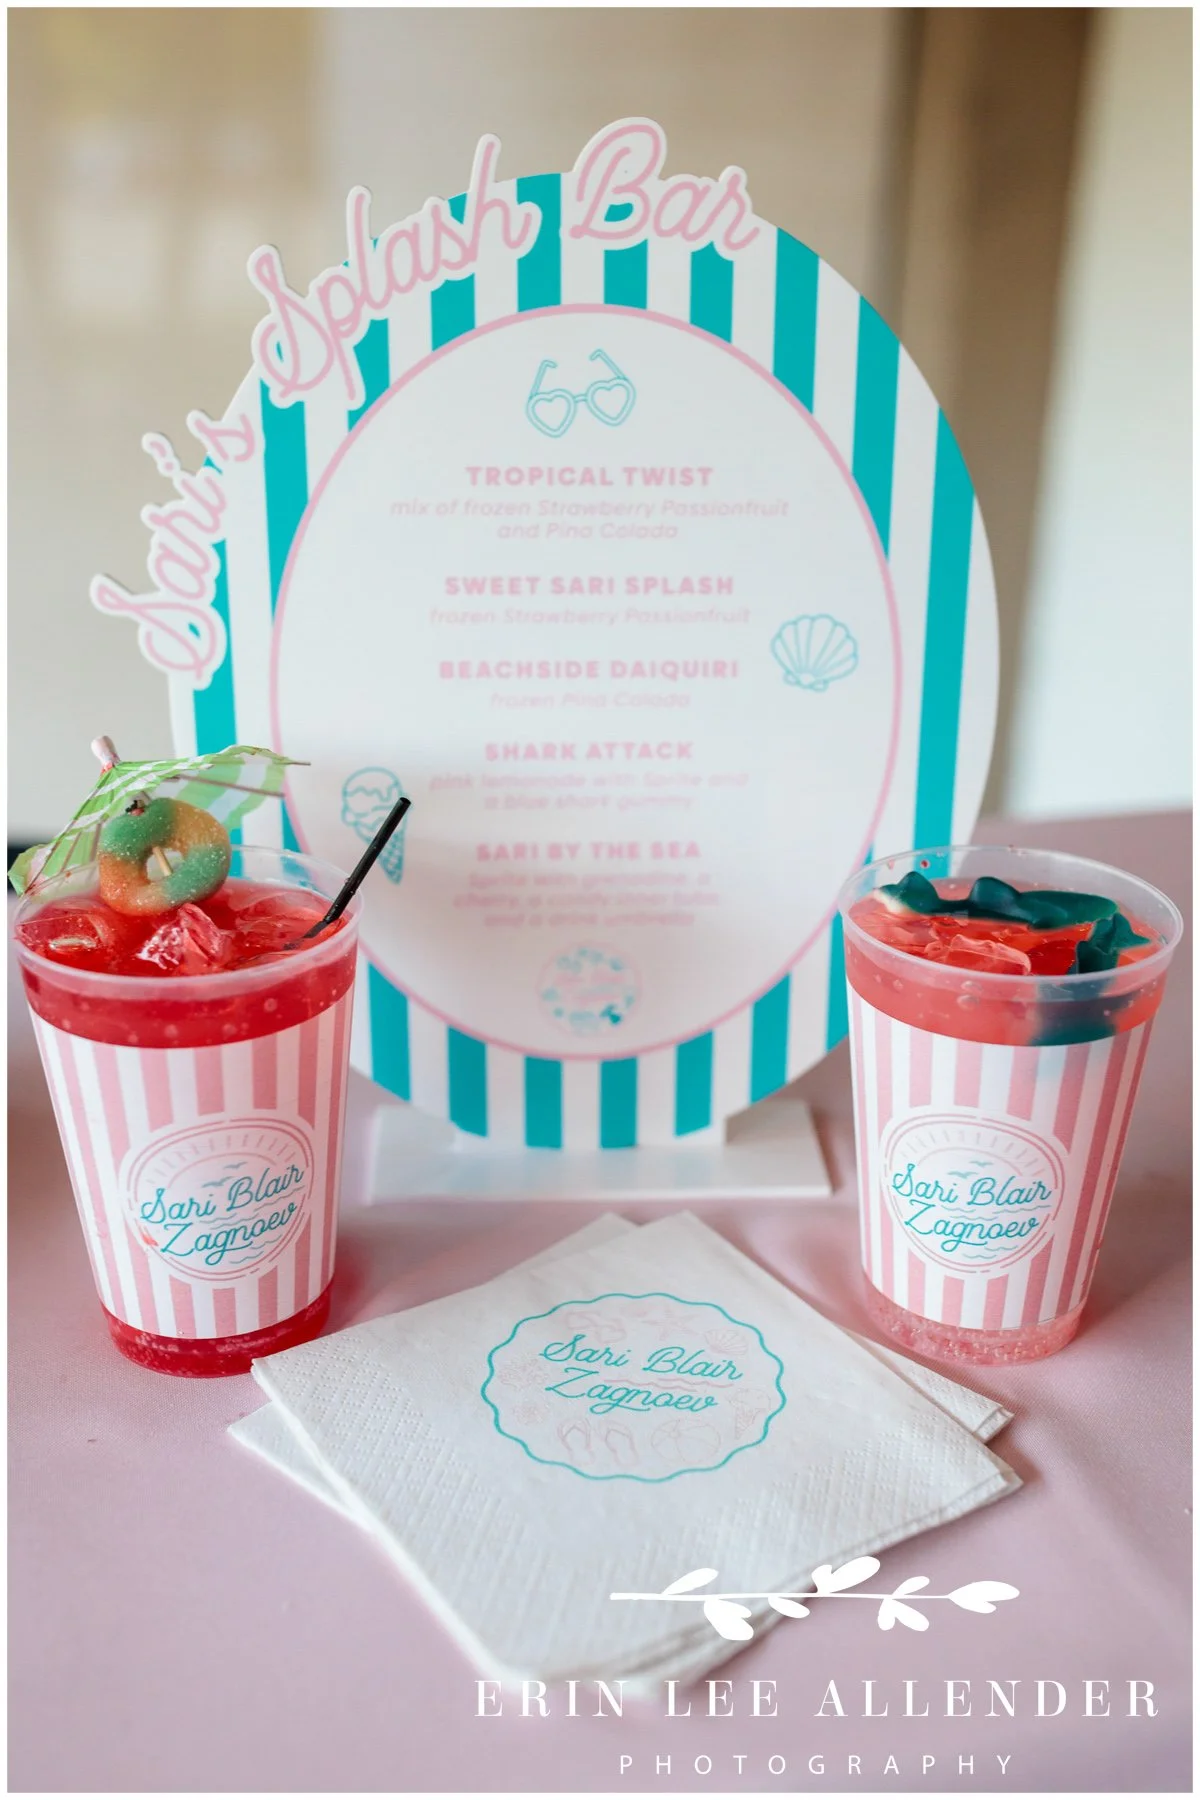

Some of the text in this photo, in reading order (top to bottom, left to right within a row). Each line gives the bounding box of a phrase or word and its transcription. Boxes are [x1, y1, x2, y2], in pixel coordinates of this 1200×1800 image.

[96, 123, 761, 682] Sari's Splash Bar
[466, 465, 714, 486] TROPICAL TWIST
[391, 498, 790, 520] mix of frozen Strawberry Passionfruit
[497, 522, 539, 539] and
[599, 522, 679, 539] Colada
[445, 576, 735, 595] SWEET SARI SPLASH
[429, 607, 751, 626] frozen Strawberry Passionfruit
[439, 660, 739, 680] BEACHSIDE DAIQUIRI
[485, 742, 694, 761] SHARK ATTACK
[476, 842, 702, 861] SARI BY THE SEA
[139, 1163, 306, 1224] Sari Blair
[891, 1162, 1053, 1207] Sari Blair
[160, 1201, 298, 1267] Zagnoev
[904, 1198, 1040, 1253] Zagnoev
[538, 1333, 744, 1381] Sari Blair
[544, 1366, 719, 1415] Zagnoev
